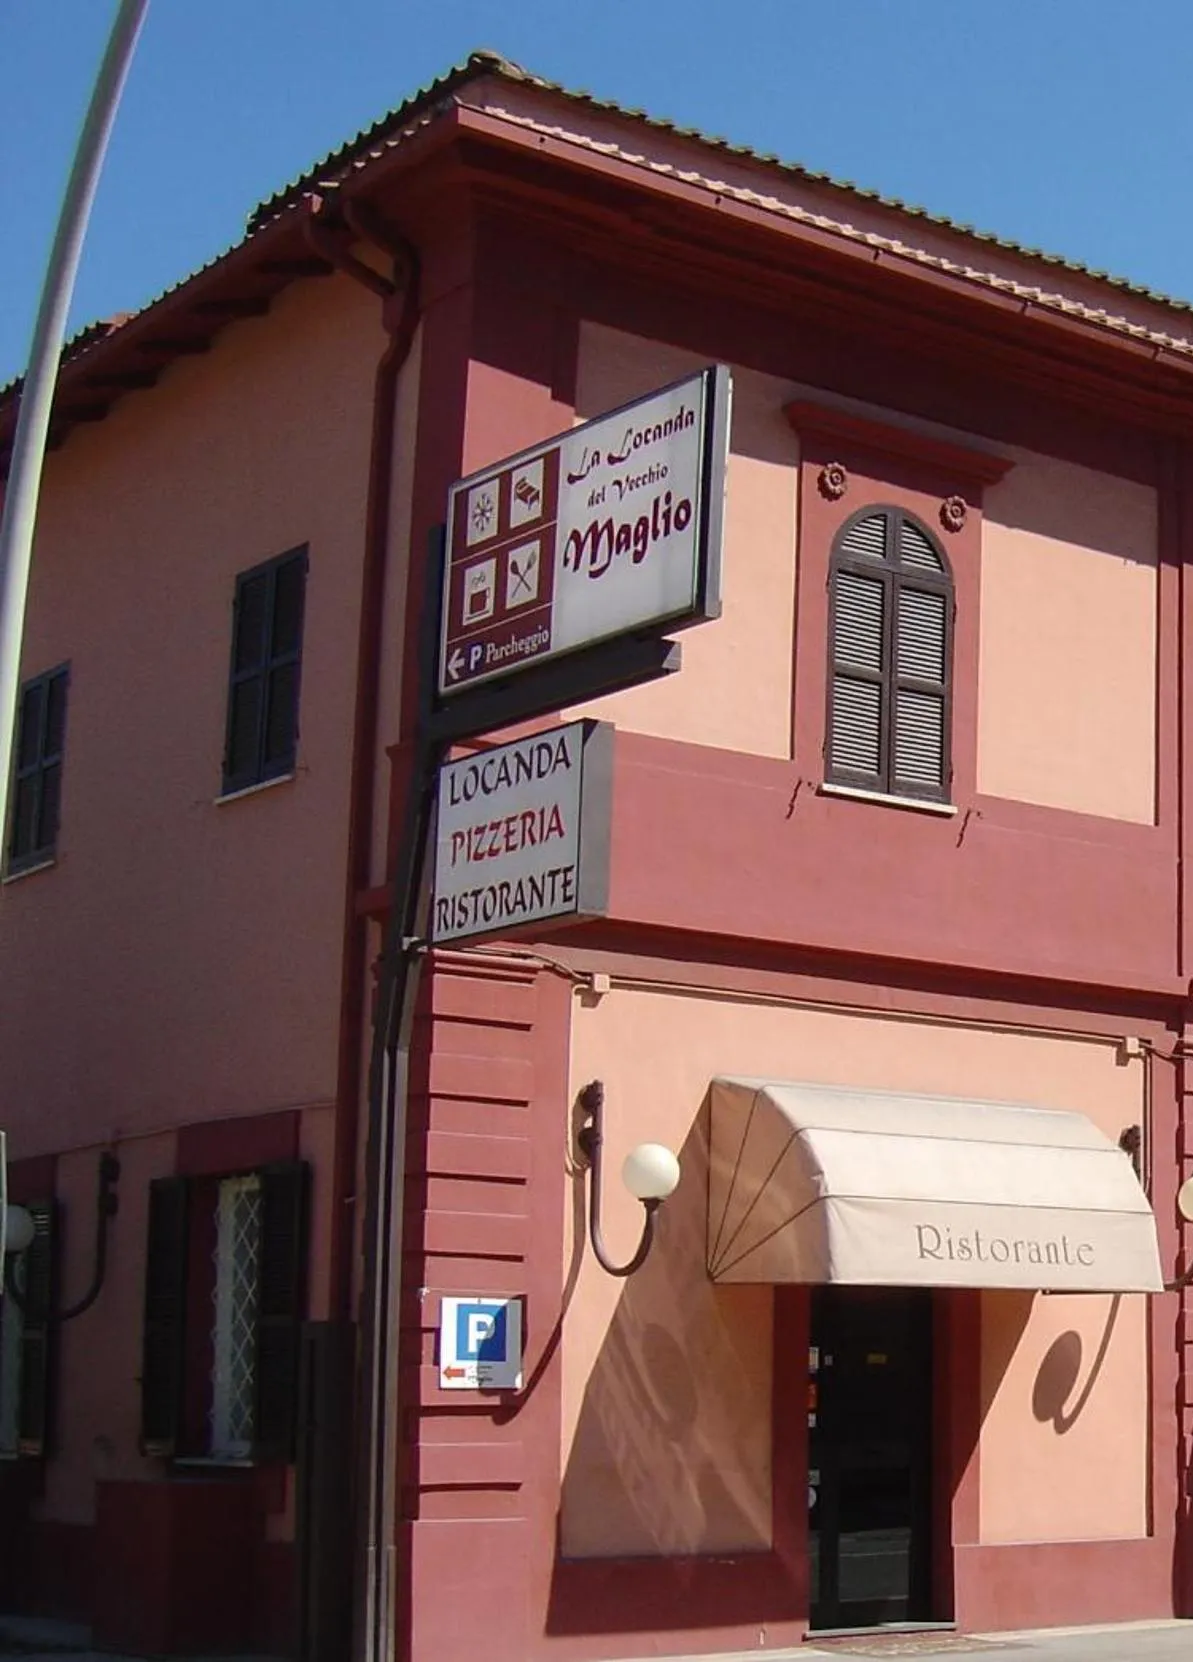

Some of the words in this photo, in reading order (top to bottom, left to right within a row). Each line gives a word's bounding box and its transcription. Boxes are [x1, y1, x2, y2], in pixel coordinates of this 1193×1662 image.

[567, 448, 601, 485] La
[607, 405, 695, 466] Locanda
[588, 486, 605, 508] del
[612, 462, 669, 501] Vecchio
[563, 490, 692, 579] Maglio
[470, 645, 482, 671] P
[486, 625, 549, 663] Parcheggio
[450, 735, 571, 806] LOCANDA
[451, 803, 564, 866] PIZZERIA
[436, 865, 575, 933] RISTORANTE
[915, 1224, 1095, 1266] Ristorante
[467, 1313, 496, 1353] P
